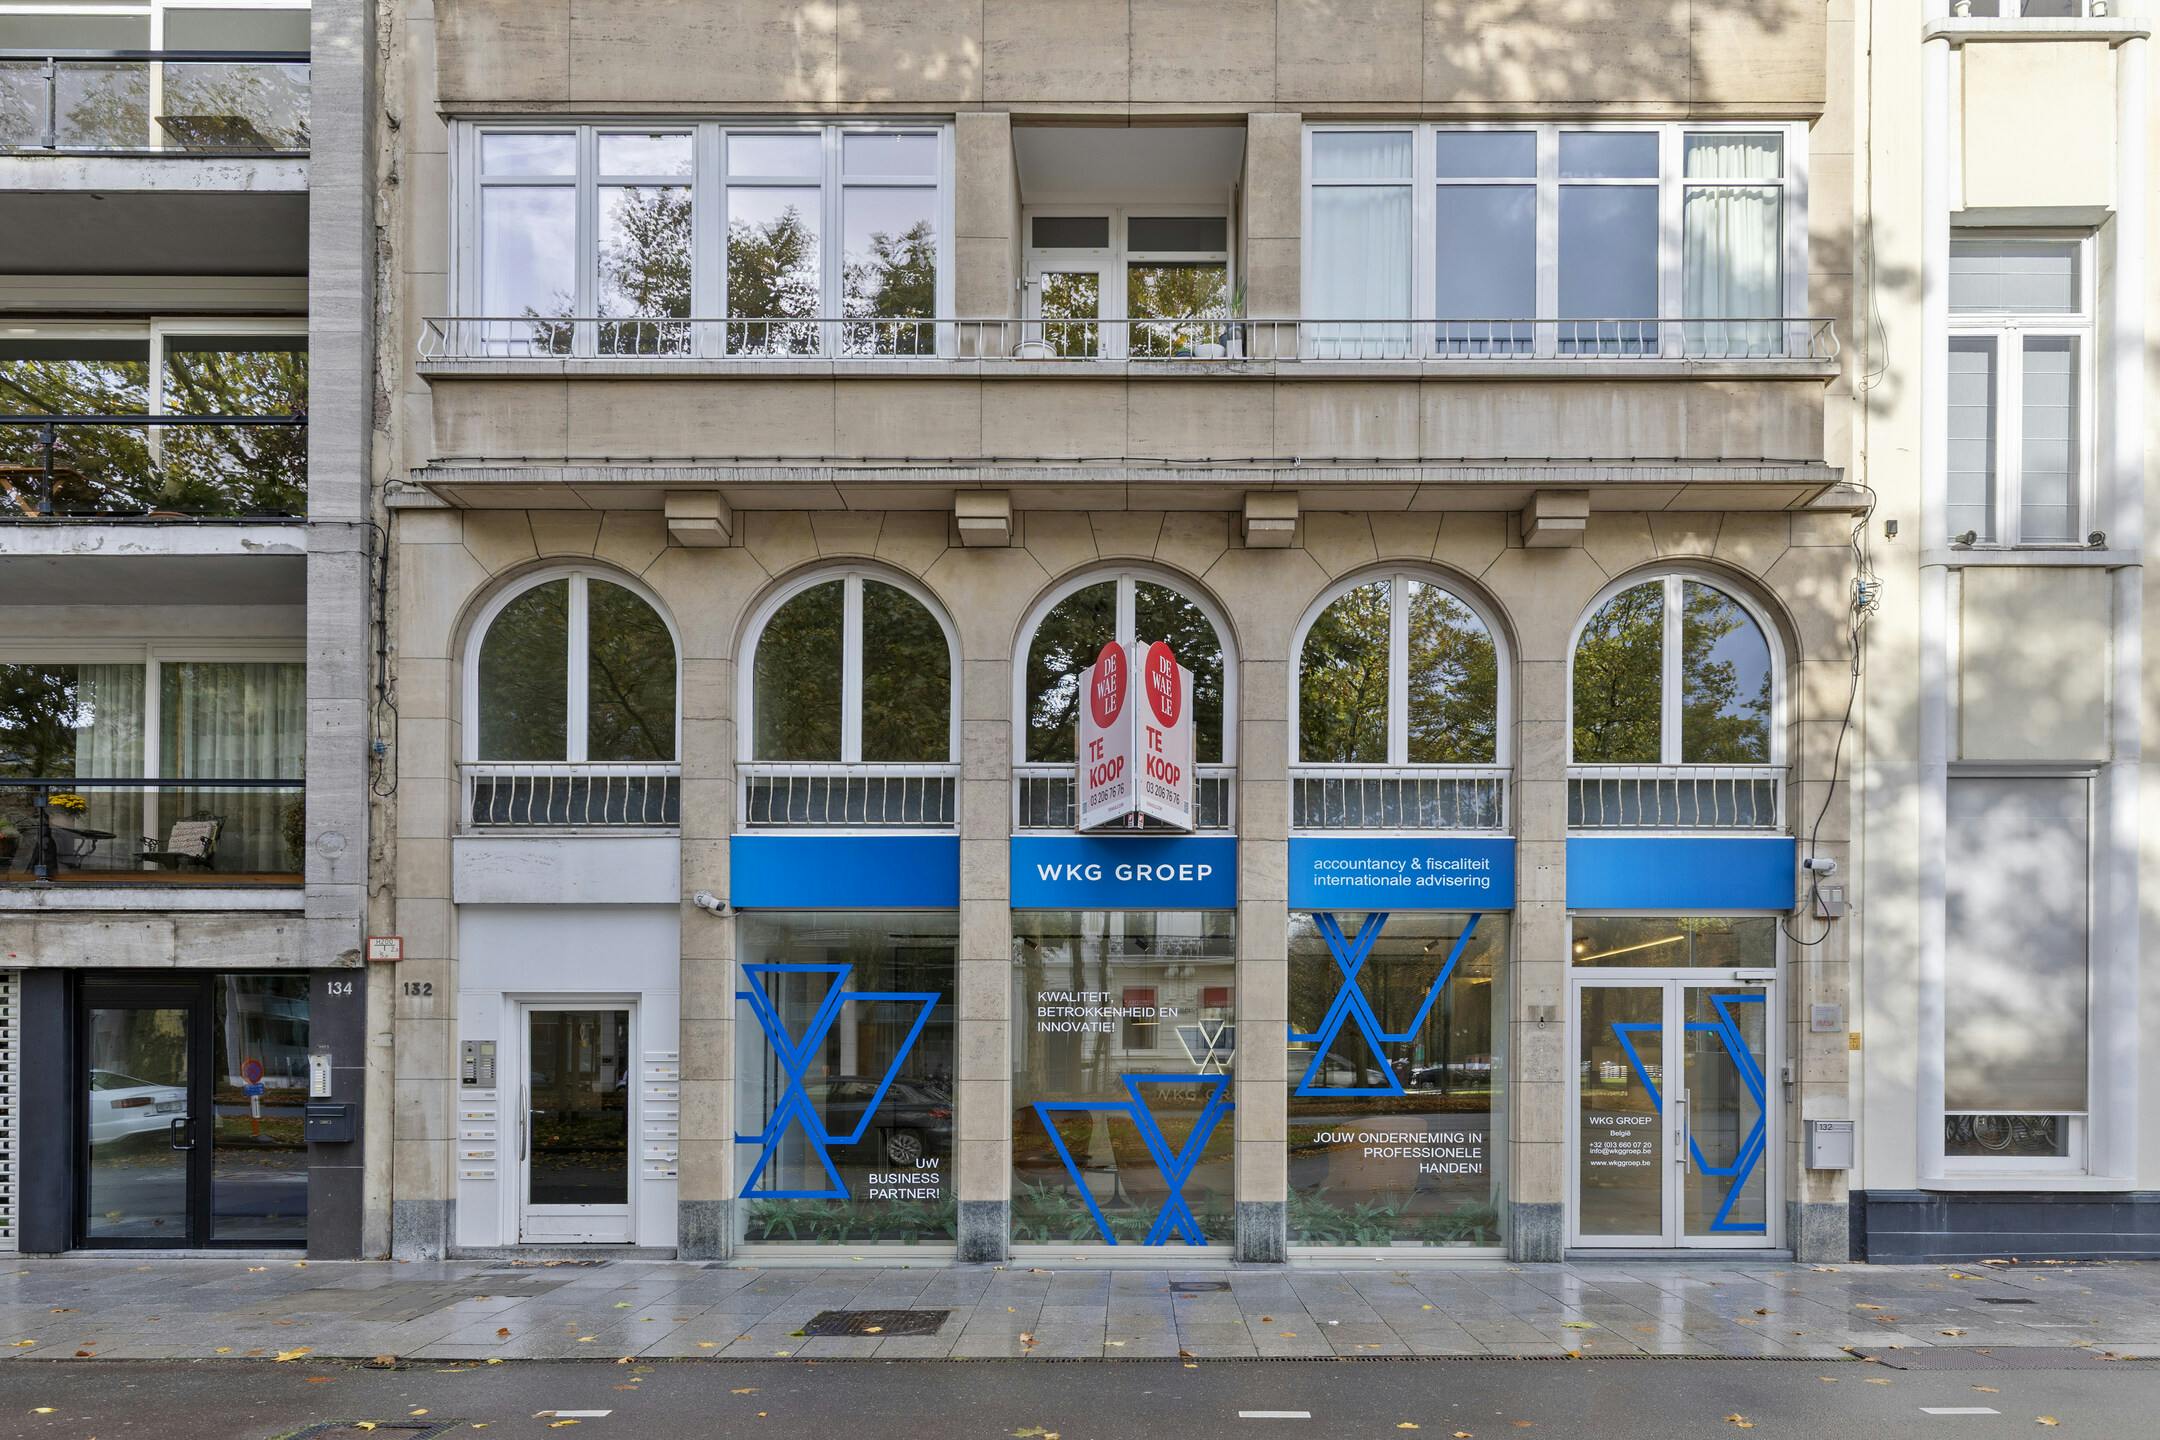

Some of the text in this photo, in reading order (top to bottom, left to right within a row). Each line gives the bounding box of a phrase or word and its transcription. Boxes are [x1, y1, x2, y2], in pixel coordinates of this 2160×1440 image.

[1104, 653, 1117, 677] DE
[1159, 655, 1172, 678] DE
[1097, 673, 1117, 700] WAE
[1152, 670, 1172, 698] WAE
[1104, 693, 1117, 716] LE
[1161, 695, 1173, 717] LE
[1145, 725, 1162, 753] TE
[1089, 736, 1104, 763] TE
[1089, 755, 1124, 790] KOOP
[1146, 753, 1181, 787] KOOP
[1090, 793, 1098, 807] 03
[1098, 789, 1109, 804] 206
[1109, 785, 1117, 799] 76
[1117, 782, 1125, 796] 76
[1146, 781, 1180, 805] 03 206 76 76
[1036, 864, 1213, 881] WKG GROEP
[1313, 857, 1490, 873] accountancy & fiscaliteit
[1313, 873, 1490, 889] internationale advisering
[327, 981, 353, 995] 134
[403, 982, 433, 996] 132
[1037, 991, 1114, 1004] KWALITEIT,
[1037, 1006, 1178, 1018] BETROKKENHEID EN
[1037, 1021, 1116, 1033] INNOVATIE!
[1589, 1116, 1652, 1125] WKG GROEP
[1819, 1123, 1833, 1131] 132
[1313, 1132, 1482, 1144] JOUW ONDERNEMING IN
[1363, 1147, 1482, 1159] PROFESSIONELE
[1419, 1162, 1482, 1174] HANDEN!
[1590, 1159, 1652, 1168] www.wkggroep.be
[868, 1172, 940, 1184] BUSINESS
[869, 1187, 940, 1199] PARTNER!
